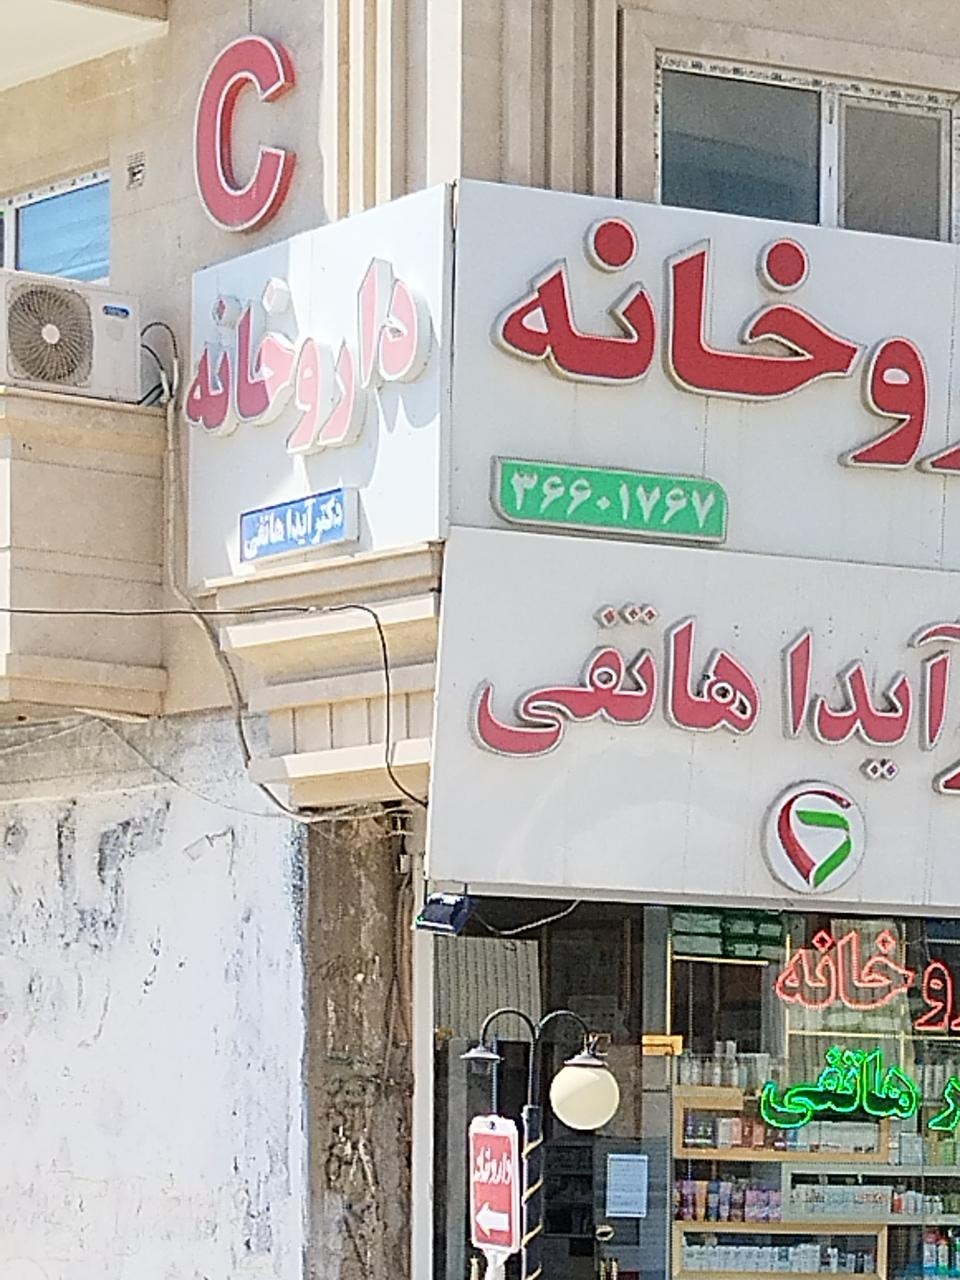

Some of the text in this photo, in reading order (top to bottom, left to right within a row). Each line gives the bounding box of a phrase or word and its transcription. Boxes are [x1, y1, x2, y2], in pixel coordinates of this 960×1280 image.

[185, 258, 431, 455] داروخانه
[285, 498, 317, 545] آیدا
[310, 495, 343, 545] دکتر
[511, 472, 715, 529] ۳۶۶۰۱۷۶۷
[471, 604, 761, 757] هاتفی
[760, 1045, 919, 1130] هاتفی
